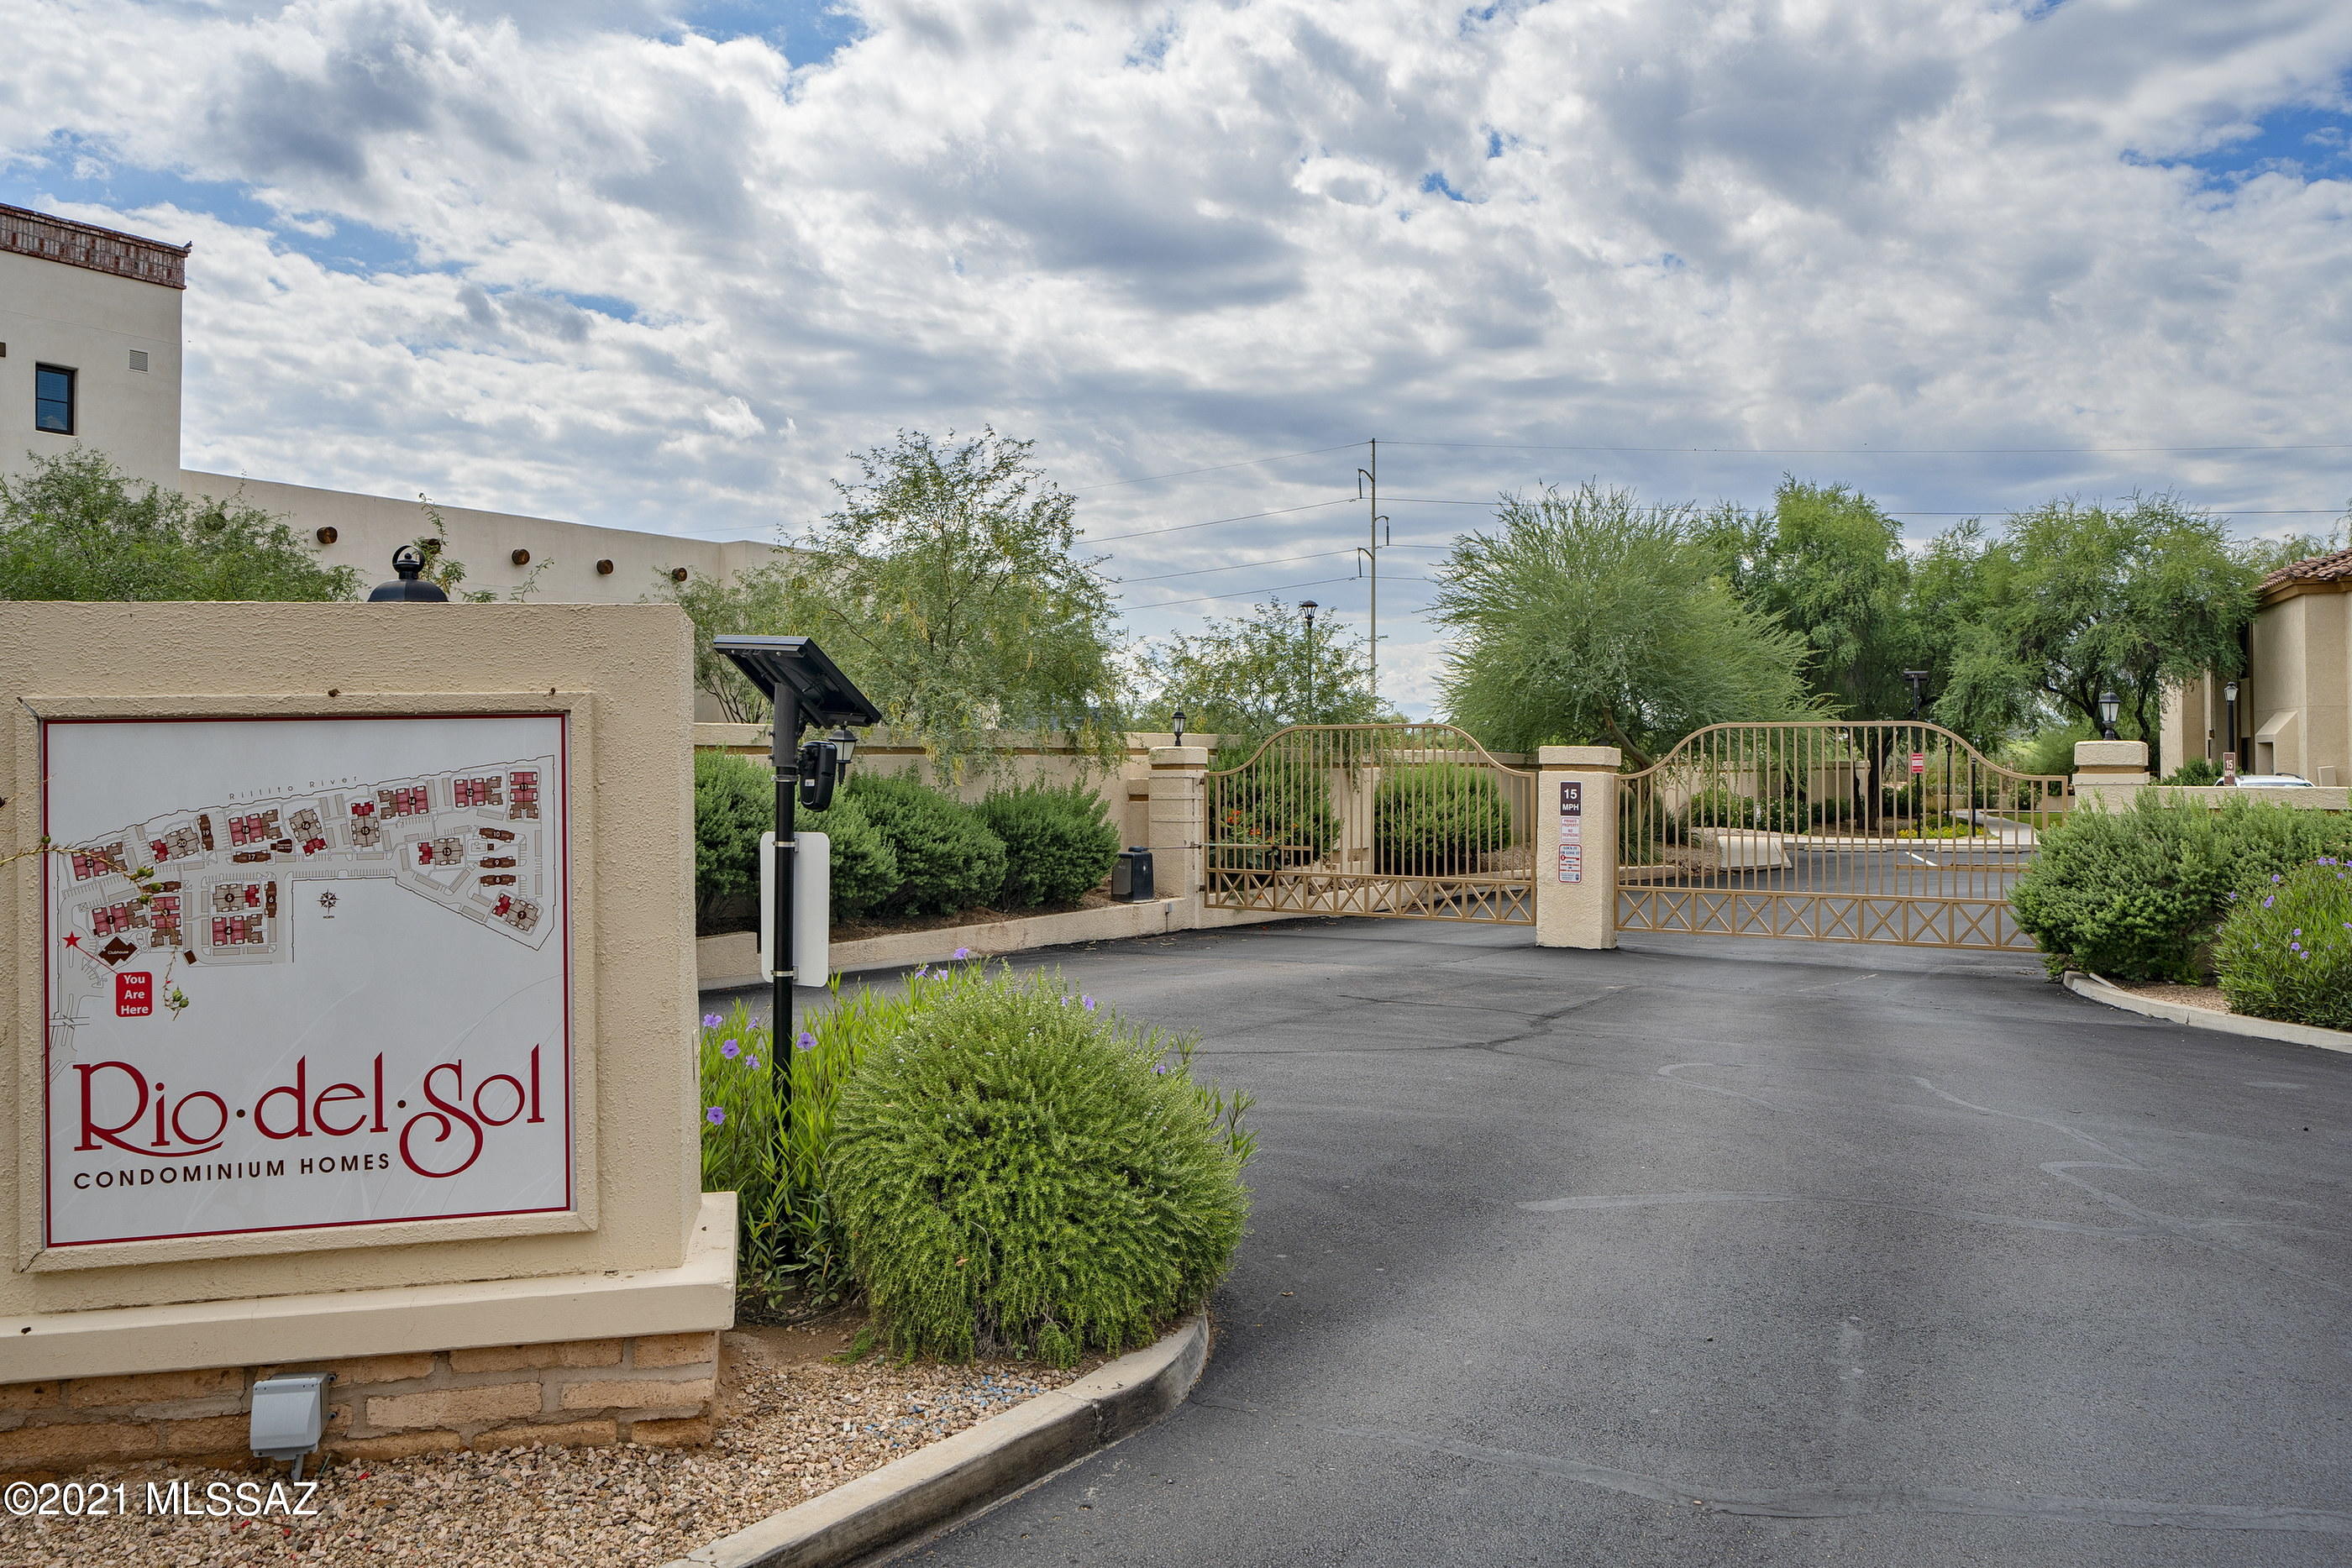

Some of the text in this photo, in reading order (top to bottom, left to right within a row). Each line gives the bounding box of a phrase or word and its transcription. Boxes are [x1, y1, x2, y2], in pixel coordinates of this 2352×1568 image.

[2225, 759, 2234, 769] 15
[1564, 789, 1578, 800] 15
[123, 974, 145, 984] You
[123, 990, 145, 999] Are
[120, 1005, 150, 1015] Here
[73, 1043, 545, 1178] Rio del Sol
[73, 1152, 390, 1190] CONDOMINIUM HOMES
